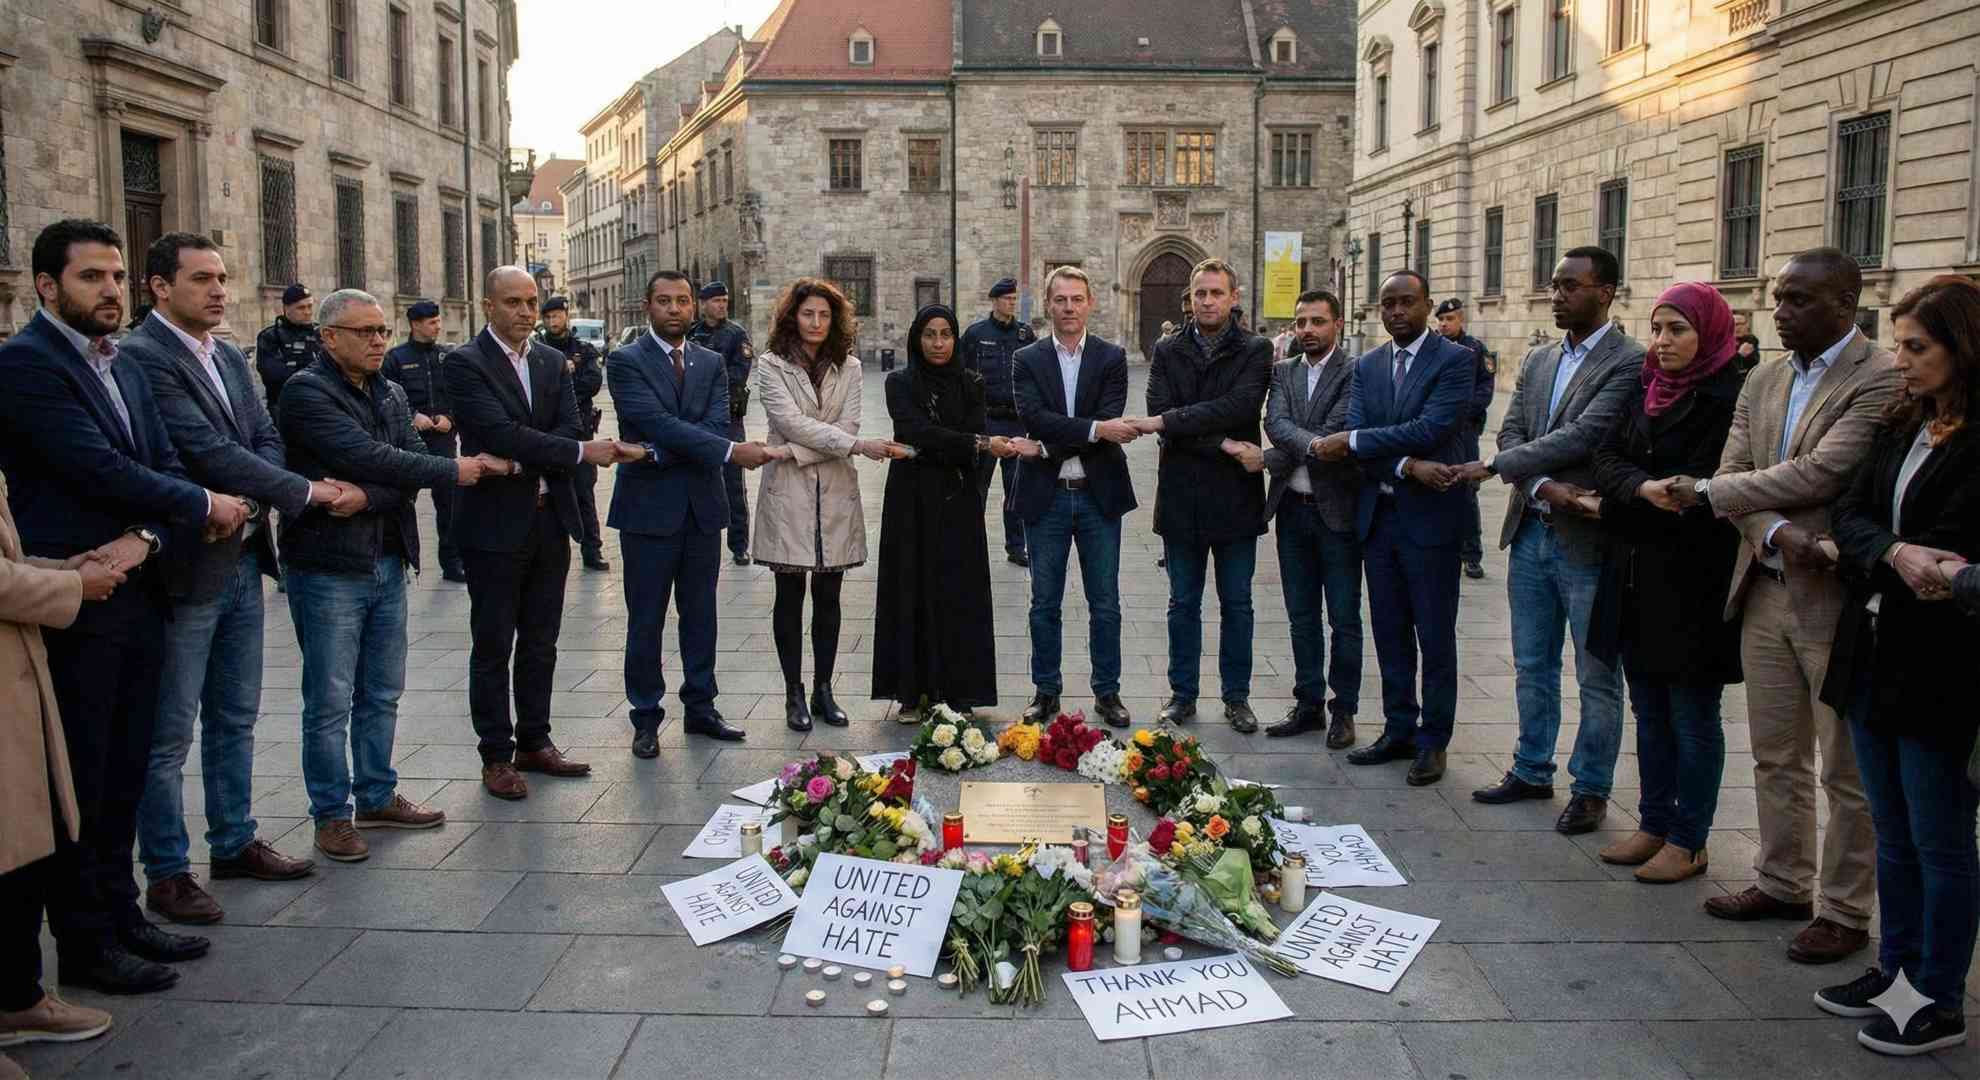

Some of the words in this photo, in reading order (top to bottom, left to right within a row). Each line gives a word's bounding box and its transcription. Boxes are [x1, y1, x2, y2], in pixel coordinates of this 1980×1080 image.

[1315, 843, 1350, 866] YOU
[1340, 834, 1390, 873] AHMAD
[712, 881, 756, 916] AGAINST
[735, 864, 783, 907] UNITED
[834, 864, 931, 899] UNITED
[683, 892, 728, 927] HATE
[822, 896, 922, 928] AGAINST
[822, 922, 900, 959] HATE
[1276, 904, 1348, 960] UNITED
[1320, 913, 1382, 969] AGAINST
[1358, 928, 1419, 973] HATE
[1075, 968, 1185, 995] THANK
[1190, 959, 1249, 981] YOU
[1116, 989, 1248, 1024] AHMAD
